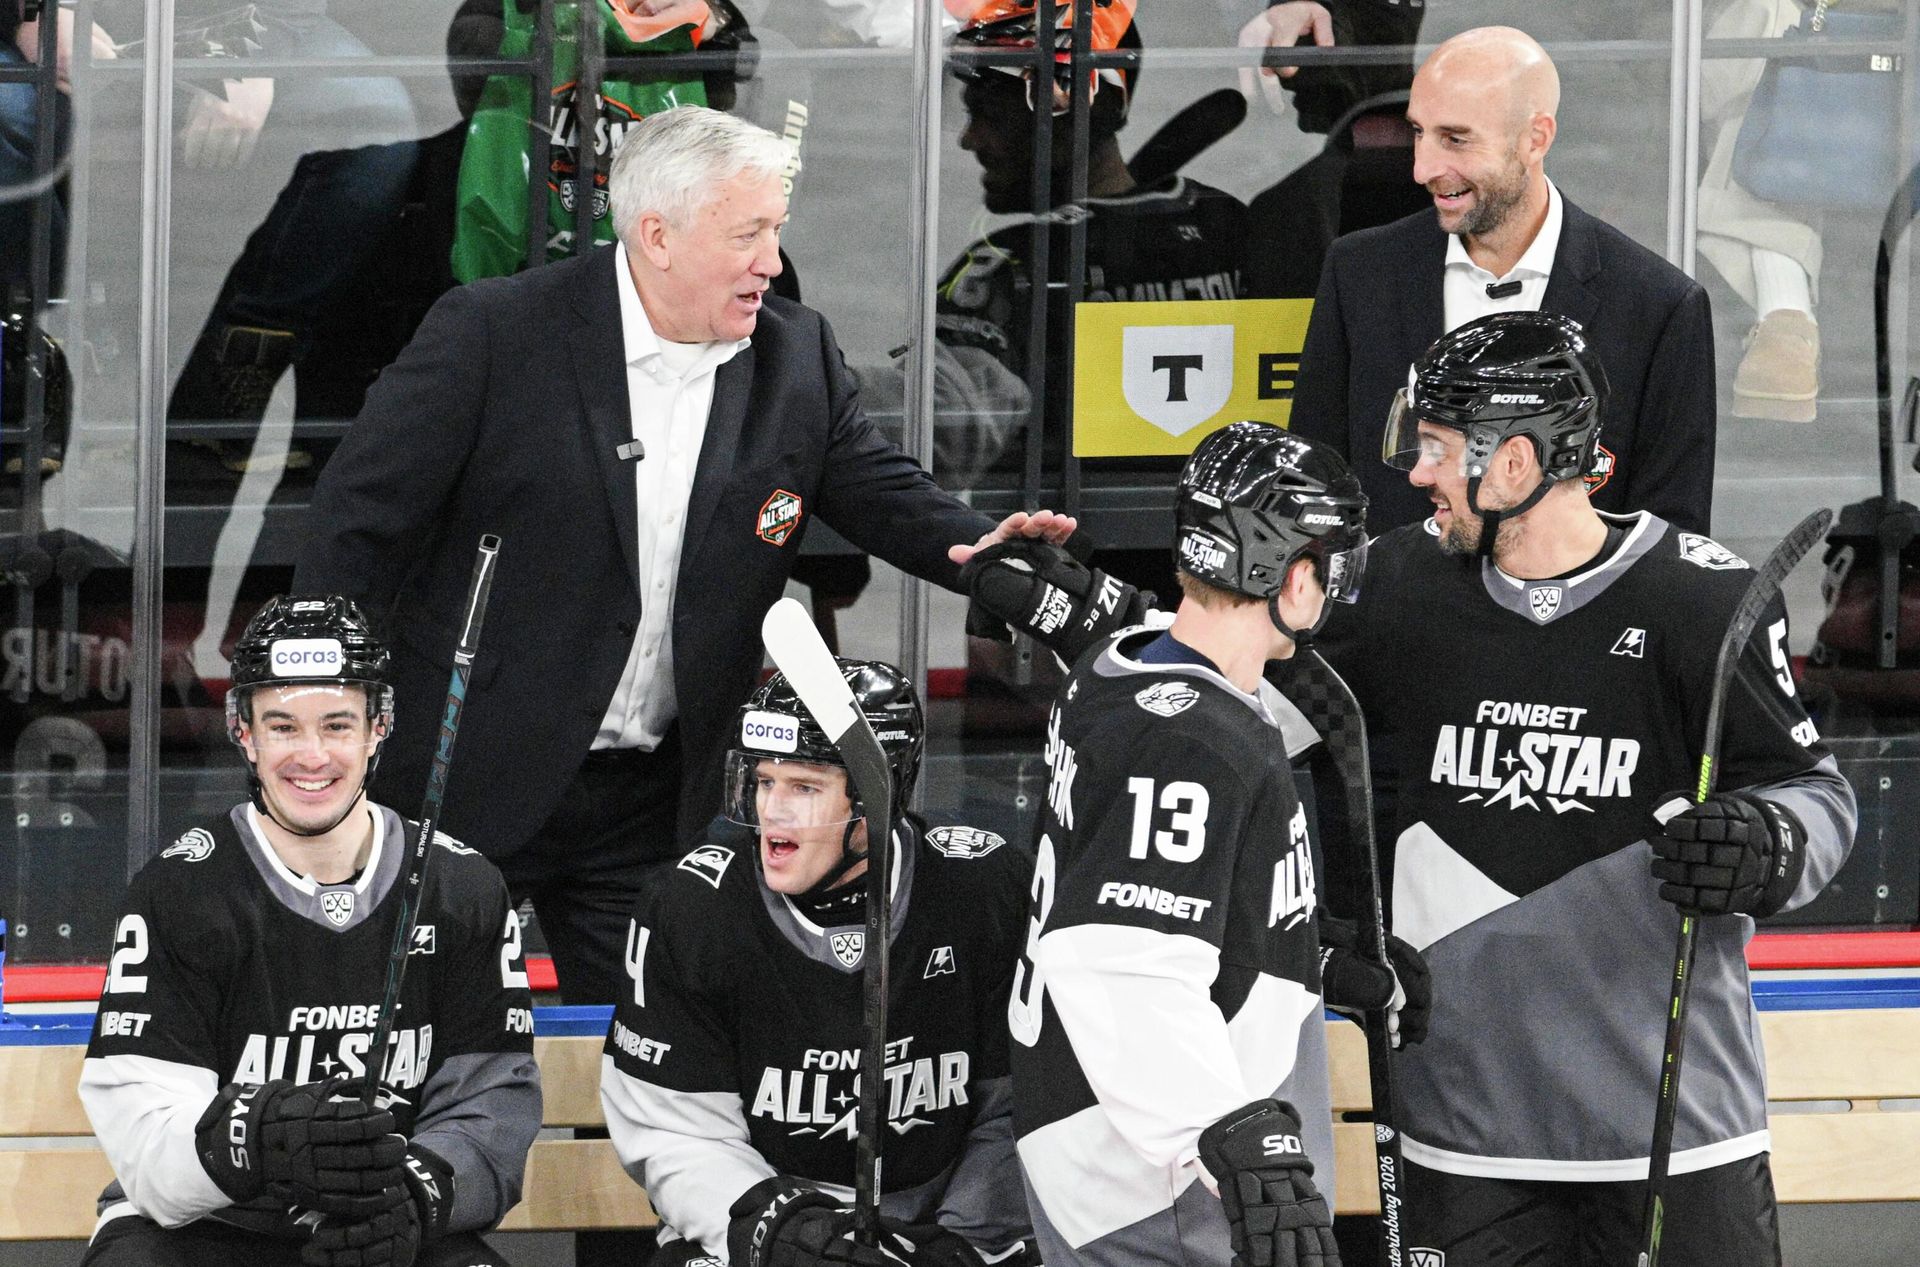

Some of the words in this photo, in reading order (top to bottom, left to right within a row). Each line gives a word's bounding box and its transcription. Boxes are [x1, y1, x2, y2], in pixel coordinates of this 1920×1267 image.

[1181, 536, 1197, 557] ALL
[1198, 545, 1227, 569] STAR
[293, 601, 326, 611] 22
[1476, 700, 1588, 731] FONBET
[1430, 724, 1503, 790] ALL
[1519, 731, 1641, 798] STAR
[1128, 776, 1210, 864] 13
[1097, 882, 1212, 922] FONBET
[103, 913, 149, 995] 2
[625, 917, 651, 1008] 4
[289, 1003, 402, 1032] FONBE
[232, 1033, 316, 1086] ALL
[803, 1036, 914, 1070] FONET
[751, 1066, 836, 1124] ALL
[229, 1084, 262, 1171] SOYU
[1379, 1156, 1396, 1192] 2026
[1382, 1193, 1402, 1267] aterinburg
